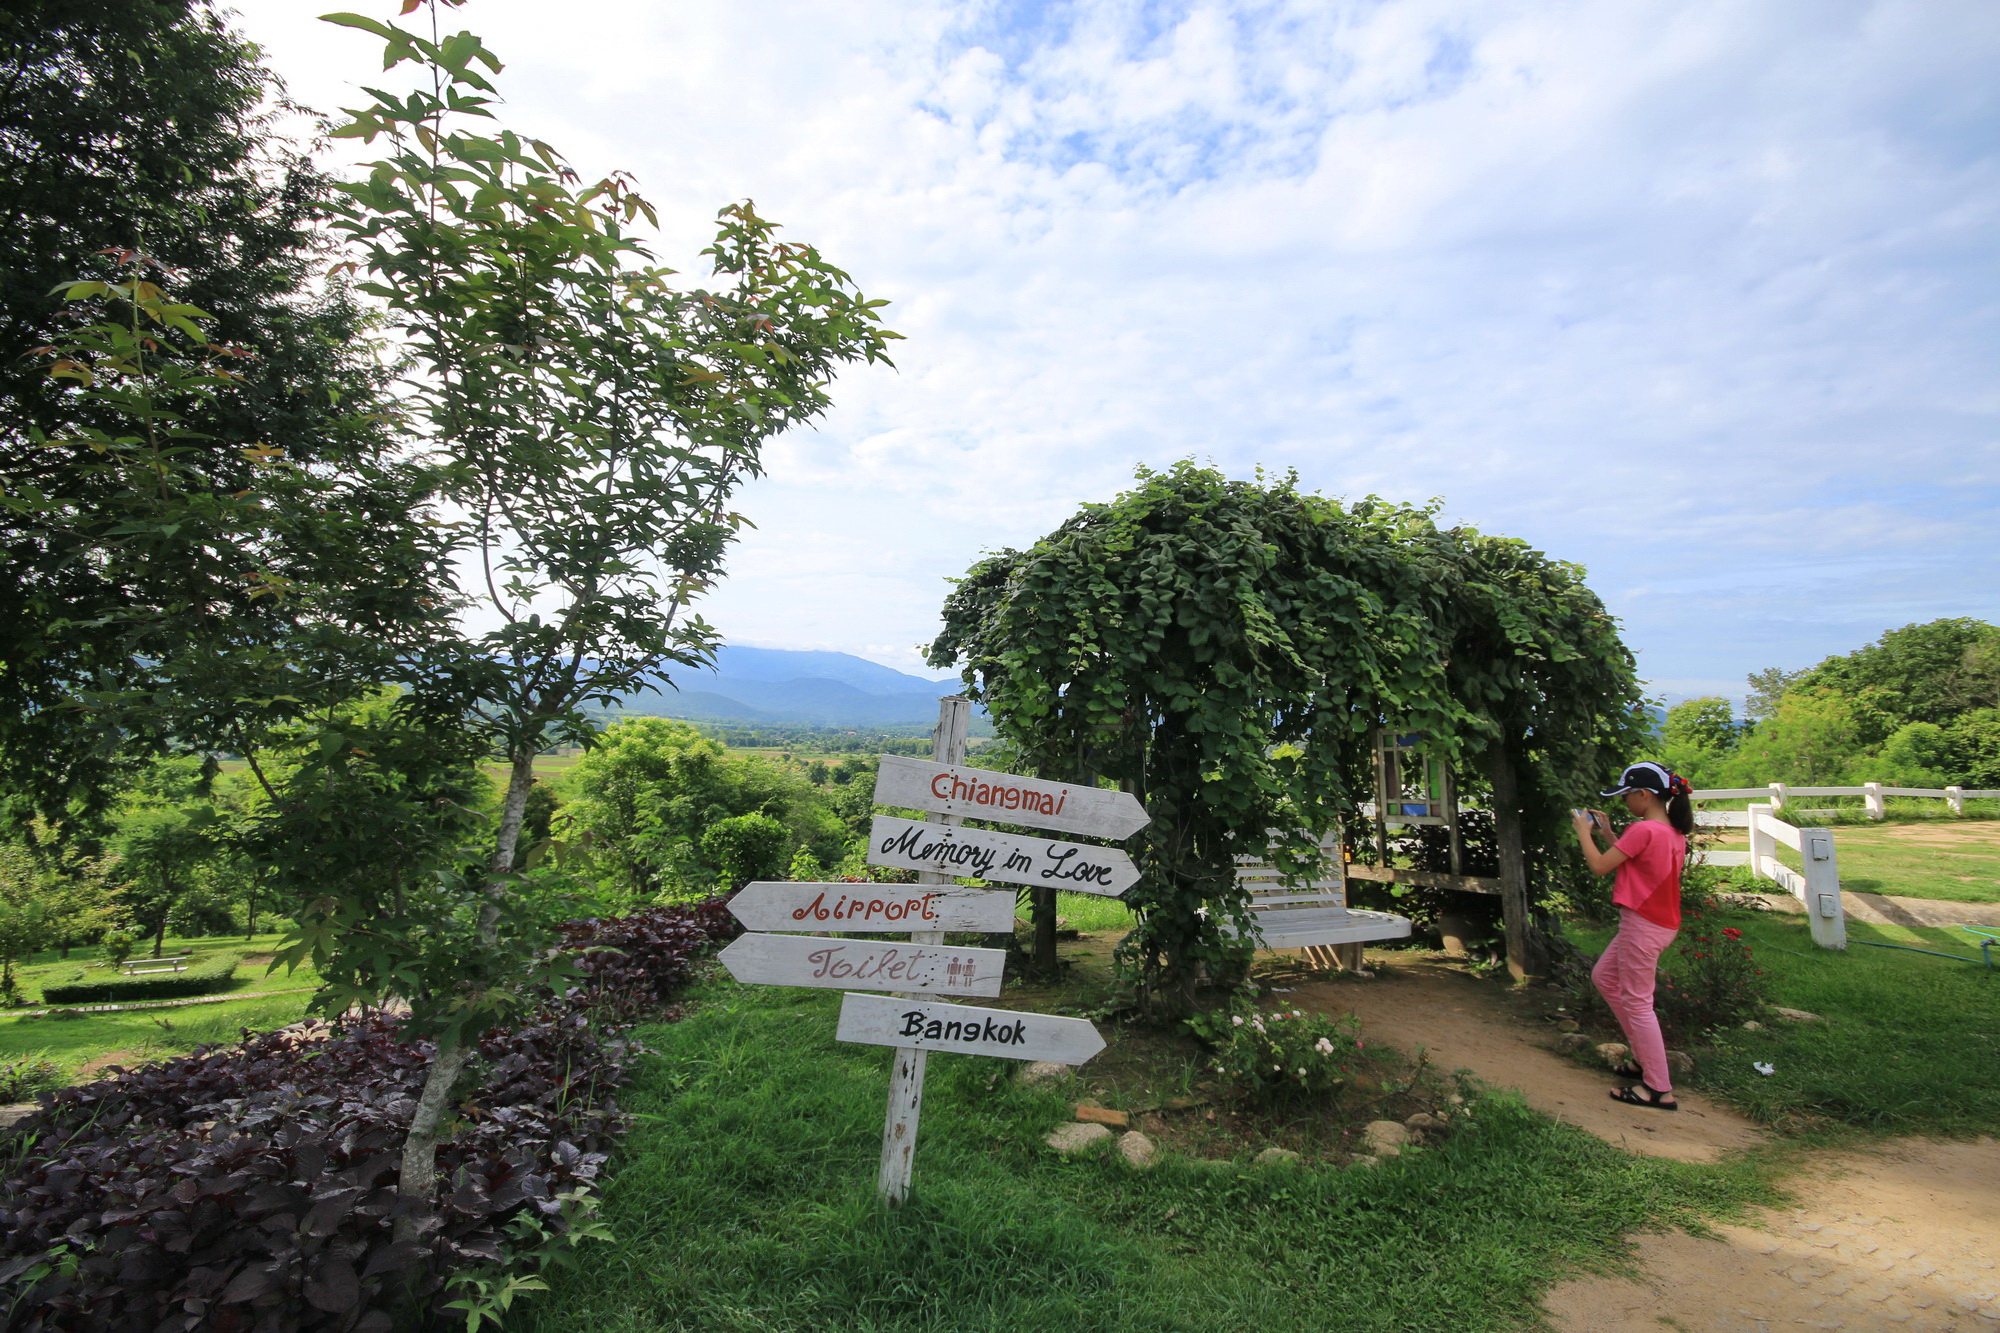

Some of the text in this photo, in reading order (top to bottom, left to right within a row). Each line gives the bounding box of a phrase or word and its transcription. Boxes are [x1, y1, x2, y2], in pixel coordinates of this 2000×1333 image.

[930, 773, 1067, 816] Chiangmai
[881, 825, 1113, 886] Memory in Love
[792, 892, 936, 921] Airport
[808, 946, 925, 982] Toilet
[899, 1011, 1026, 1045] Bangkok
